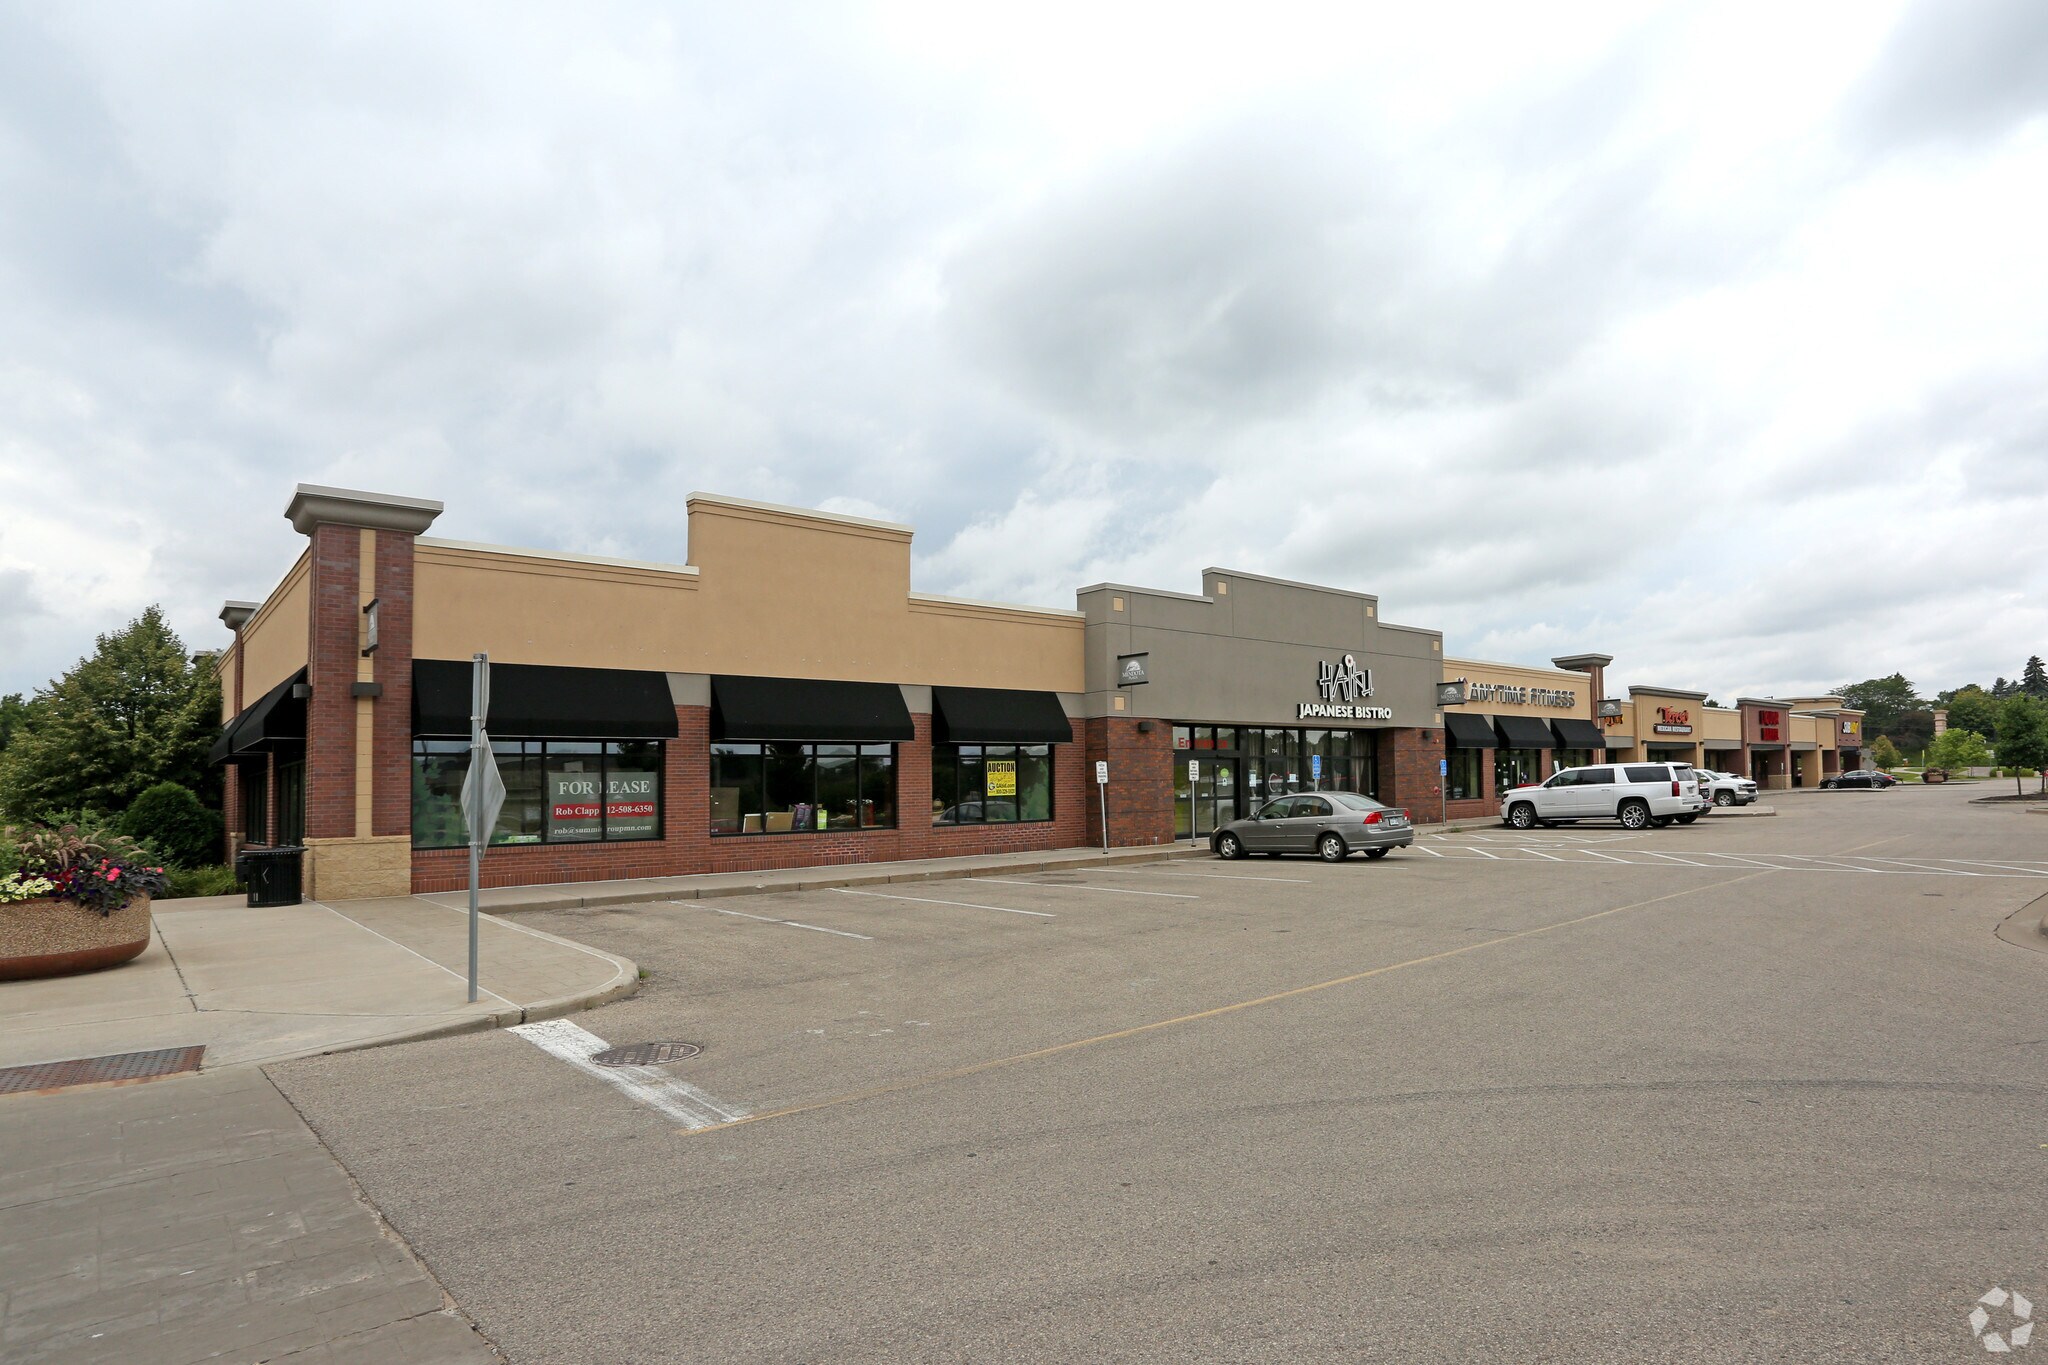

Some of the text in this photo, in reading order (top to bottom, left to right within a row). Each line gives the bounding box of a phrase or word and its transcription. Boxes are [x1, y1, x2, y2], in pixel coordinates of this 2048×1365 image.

[1470, 682, 1576, 708] ANYTIME FITNESS
[1298, 703, 1392, 719] JAPANESE BISTRO
[987, 762, 1015, 773] AUCTION
[558, 781, 593, 795] FOR
[555, 804, 653, 817] Rob Clapp 12-508-6350
[554, 824, 652, 836] rob@summiroupmn.com
